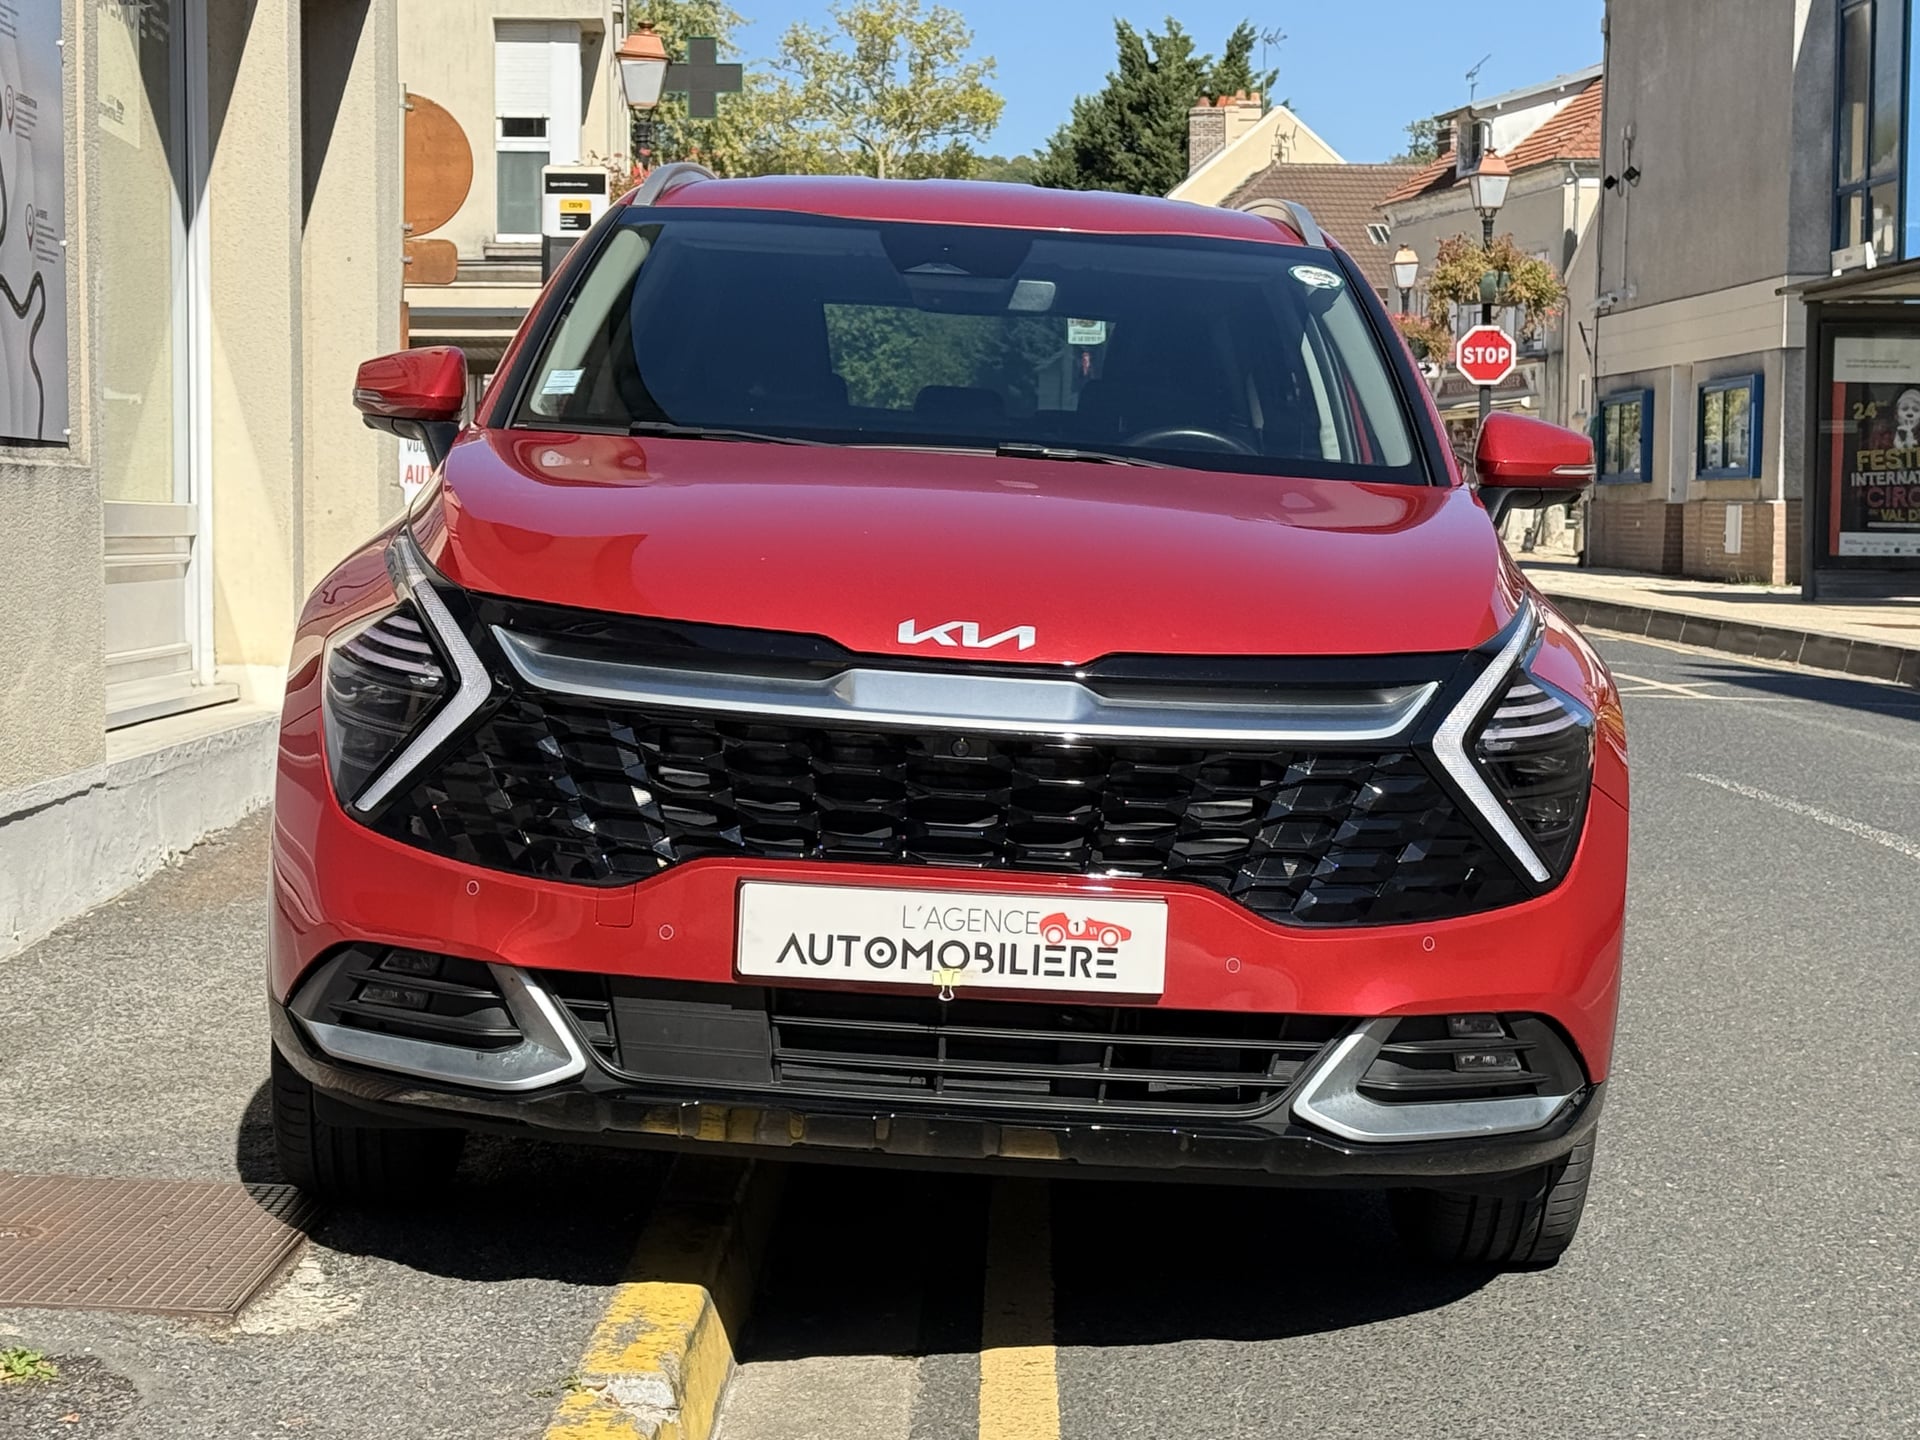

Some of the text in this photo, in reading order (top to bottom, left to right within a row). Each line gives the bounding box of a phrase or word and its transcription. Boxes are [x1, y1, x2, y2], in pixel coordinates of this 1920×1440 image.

[1463, 346, 1510, 364] STOP
[897, 618, 1037, 652] KIA
[902, 904, 1041, 935] L'AGENCE
[1072, 920, 1080, 933] 1
